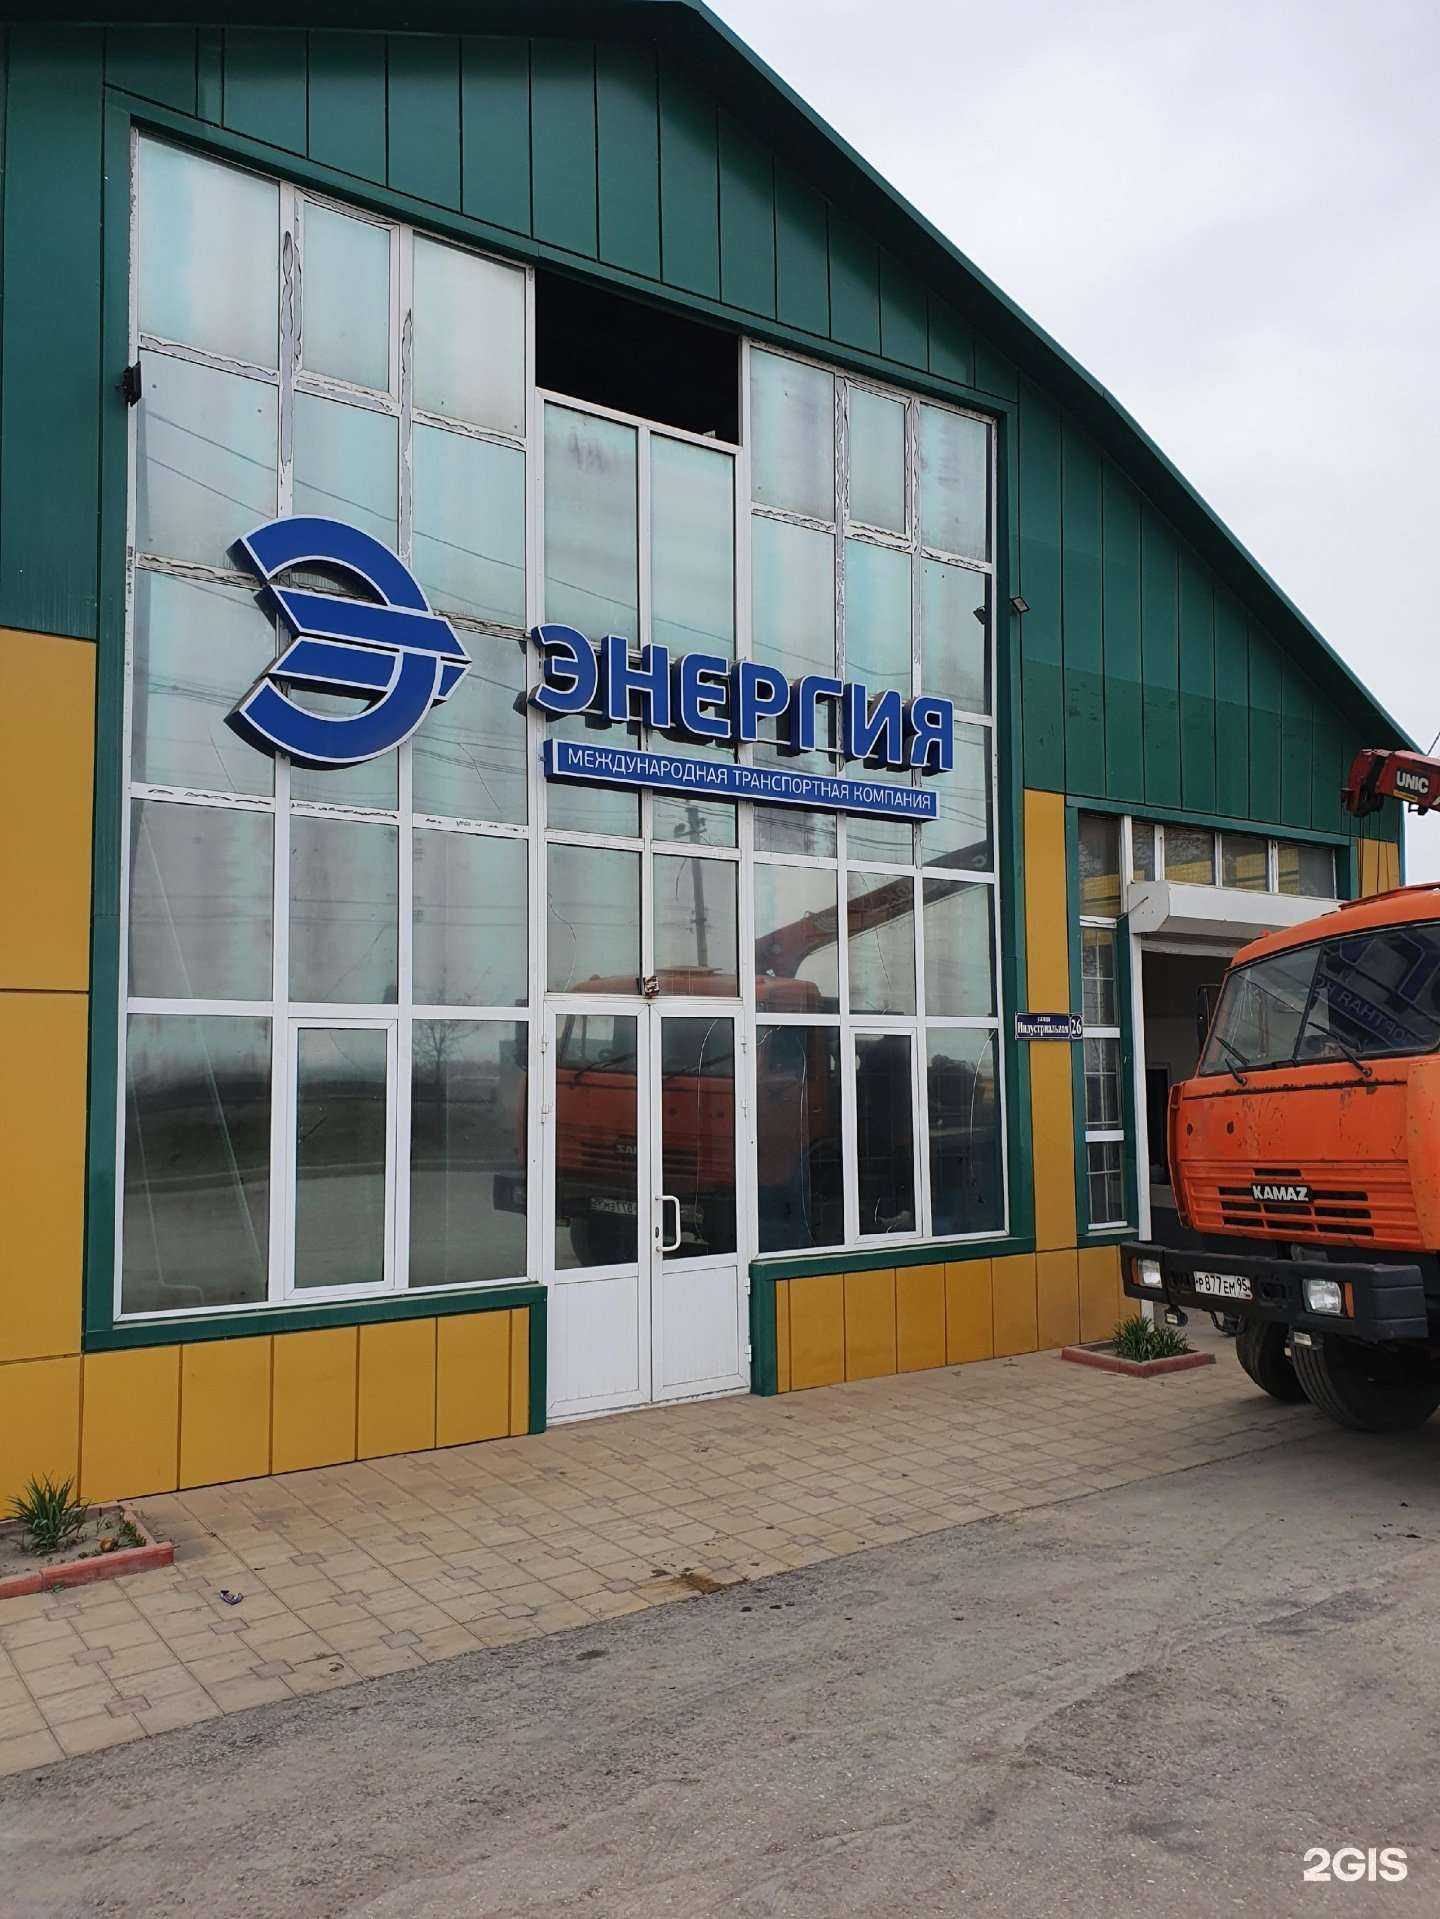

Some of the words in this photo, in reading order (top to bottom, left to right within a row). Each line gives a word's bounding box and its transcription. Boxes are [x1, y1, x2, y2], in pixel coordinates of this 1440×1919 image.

[531, 623, 954, 771] ЭНЕРГИЯ
[568, 748, 727, 784] МЕЖДУНАРОДНАЯ
[733, 769, 848, 799] ТРАНСПОРТНАЯ
[854, 790, 931, 810] КОМПАНИЯ
[1397, 771, 1429, 794] UNIC
[1071, 1019, 1082, 1035] 26
[1252, 1185, 1309, 1201] KAMAZ
